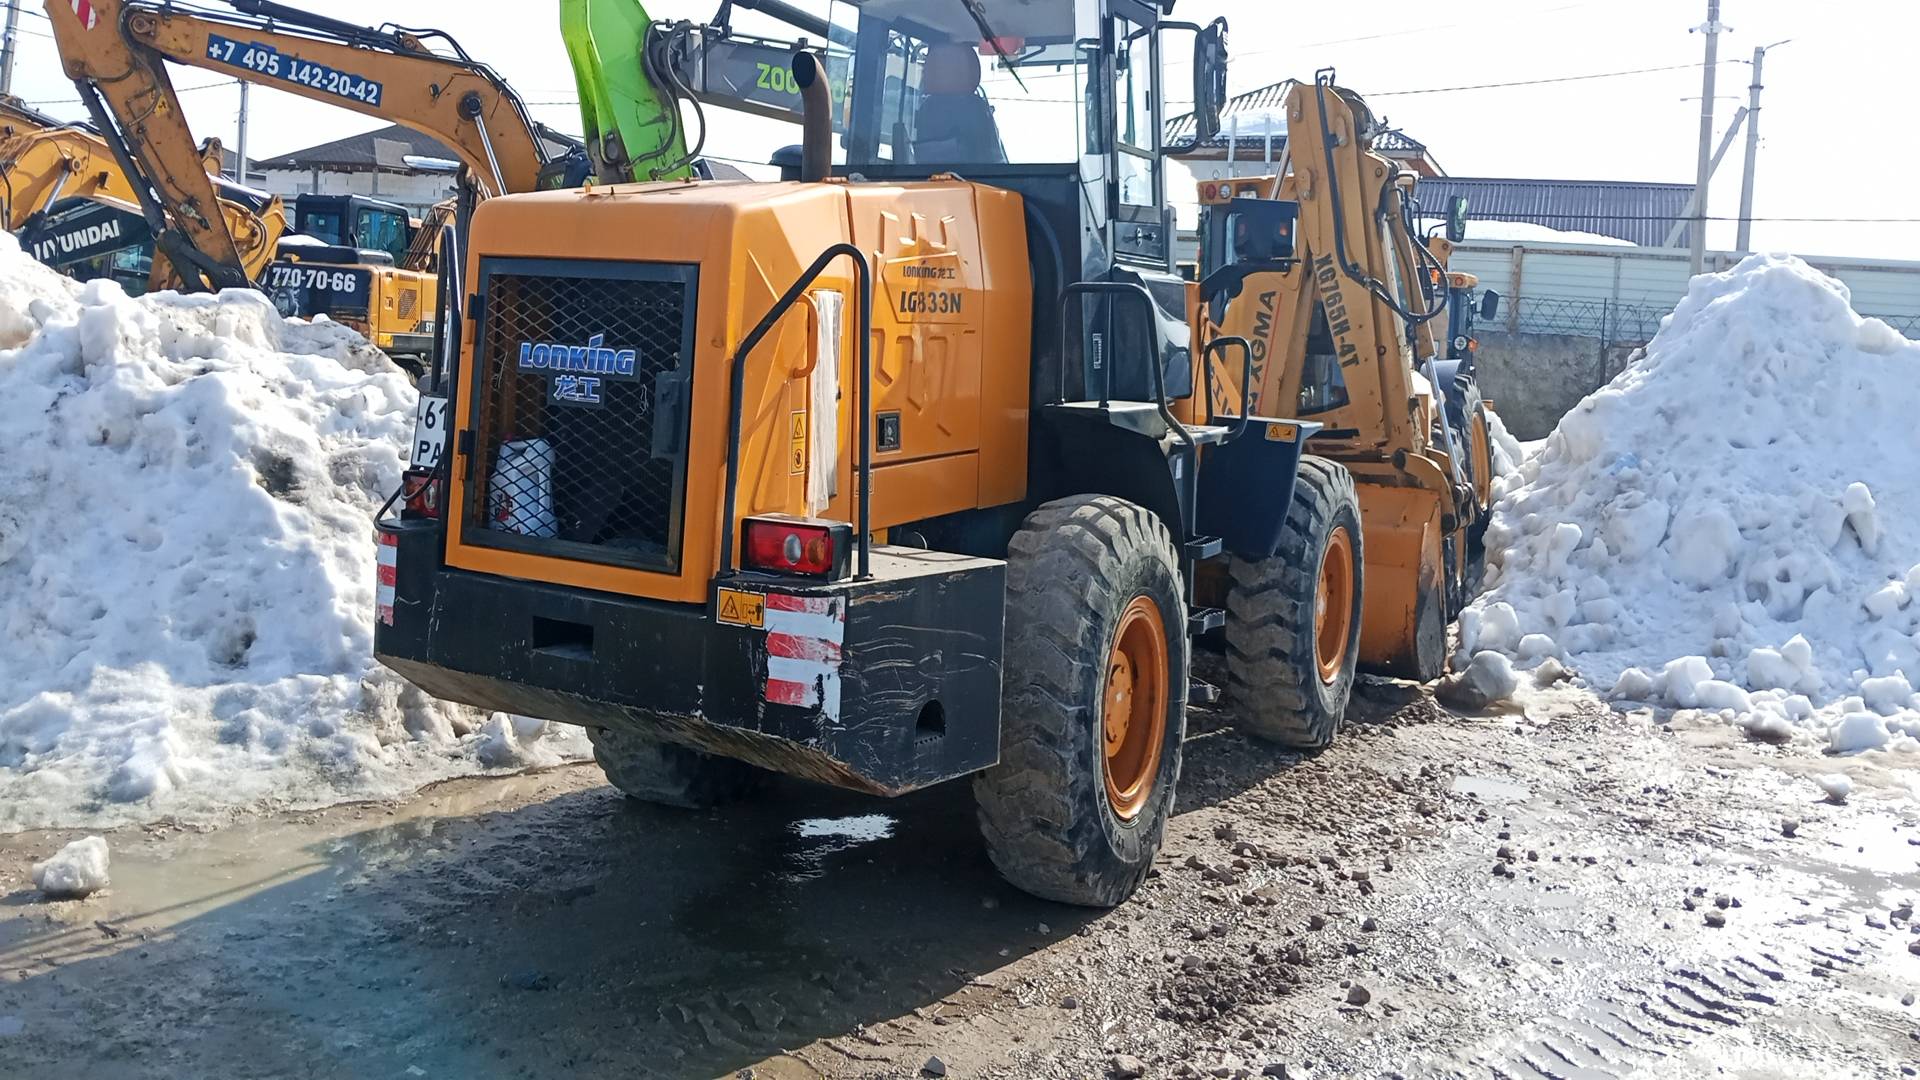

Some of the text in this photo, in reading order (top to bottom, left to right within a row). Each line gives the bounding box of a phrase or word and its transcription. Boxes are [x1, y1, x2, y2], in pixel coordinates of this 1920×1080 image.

[209, 41, 378, 104] +7 495 142-20-42
[33, 219, 120, 260] HYUNDAI
[272, 267, 357, 293] 770-70-66
[900, 291, 962, 314] LG833N
[1314, 253, 1360, 369] XG765H-4T
[1250, 290, 1277, 384] XGMA
[553, 374, 601, 404] 龙工
